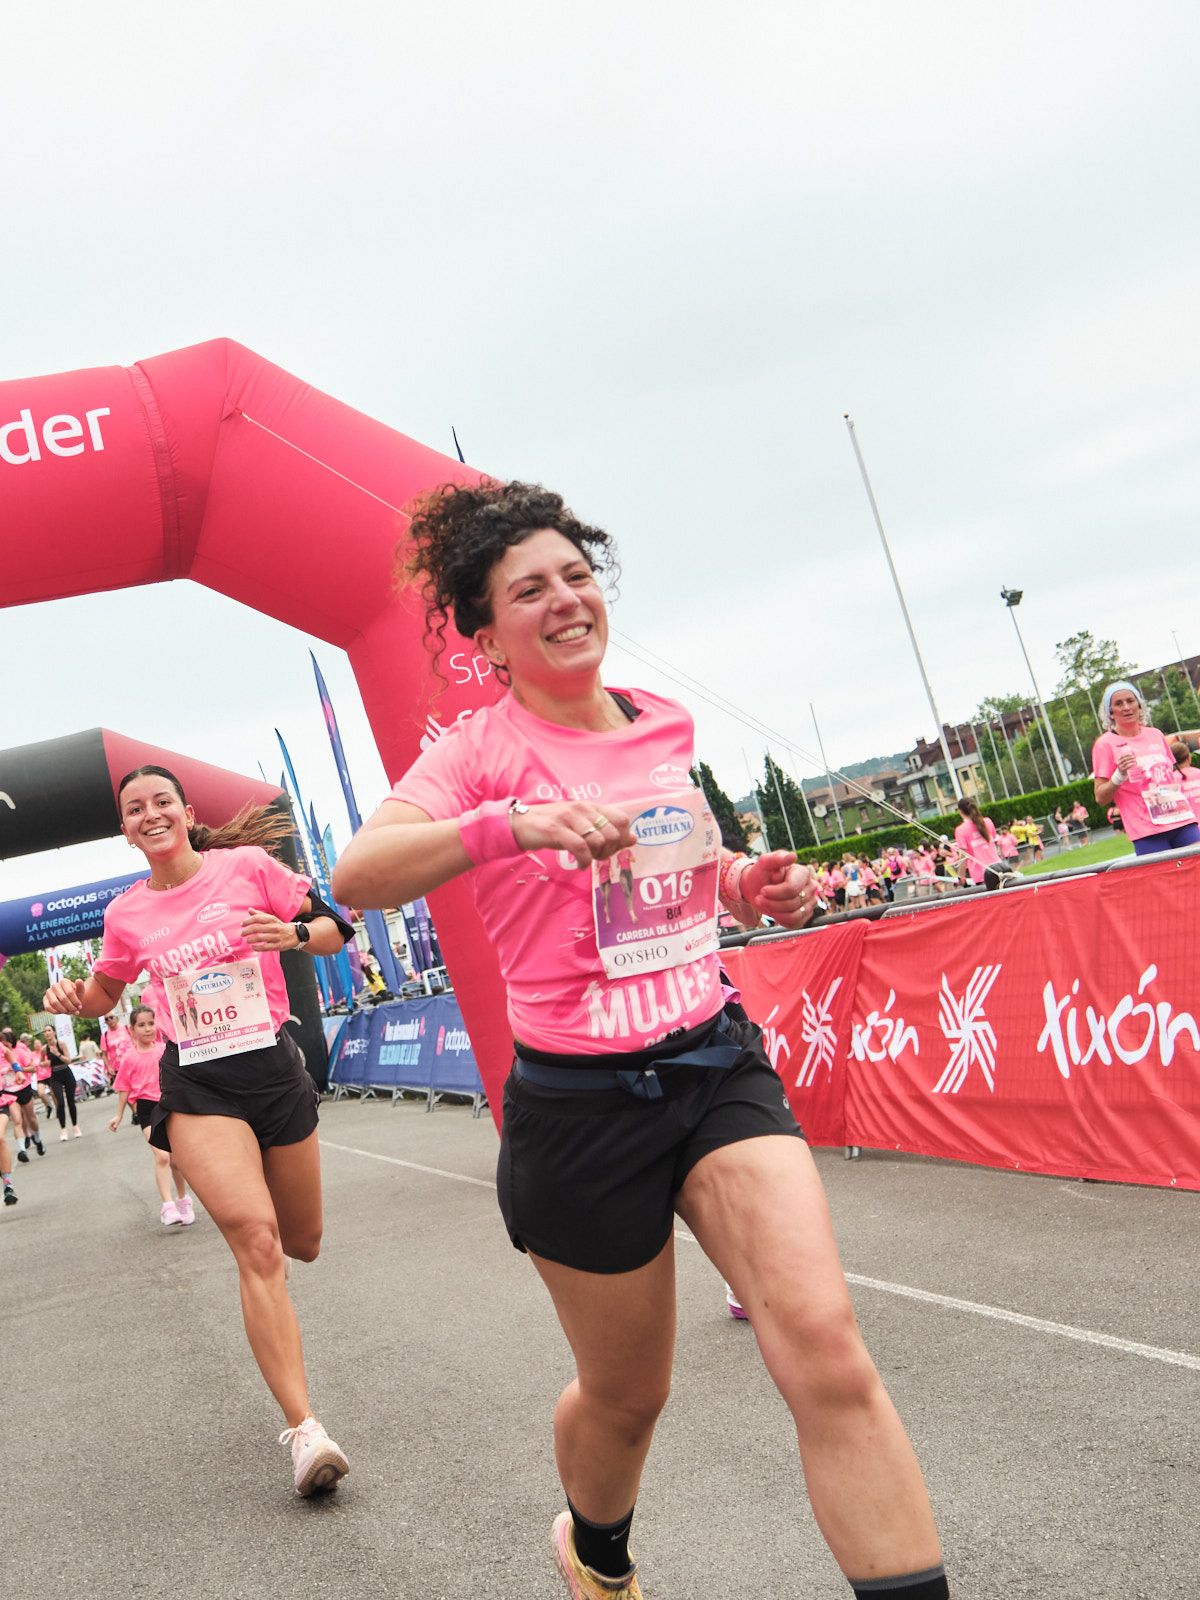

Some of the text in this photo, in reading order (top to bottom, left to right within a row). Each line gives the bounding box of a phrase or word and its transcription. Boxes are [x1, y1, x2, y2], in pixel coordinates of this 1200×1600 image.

[536, 782, 602, 801] OYHO
[634, 822, 692, 840] ASTURIANA
[639, 870, 693, 905] 016
[47, 891, 98, 912] octopus
[26, 923, 38, 933] LA
[40, 913, 80, 930] ENERGÍA
[36, 931, 48, 941] LA
[51, 920, 104, 938] VELOCIDAD
[616, 927, 654, 943] CARRERA
[656, 924, 668, 936] DE
[668, 922, 680, 934] LA
[150, 930, 233, 979] CARRERA
[613, 945, 669, 967] OYSHO
[195, 979, 231, 992] ASTURIANA
[587, 958, 710, 1039] MUJER
[201, 1005, 238, 1026] 016
[213, 1023, 231, 1034] 2102
[189, 1046, 218, 1059] OYSHO
